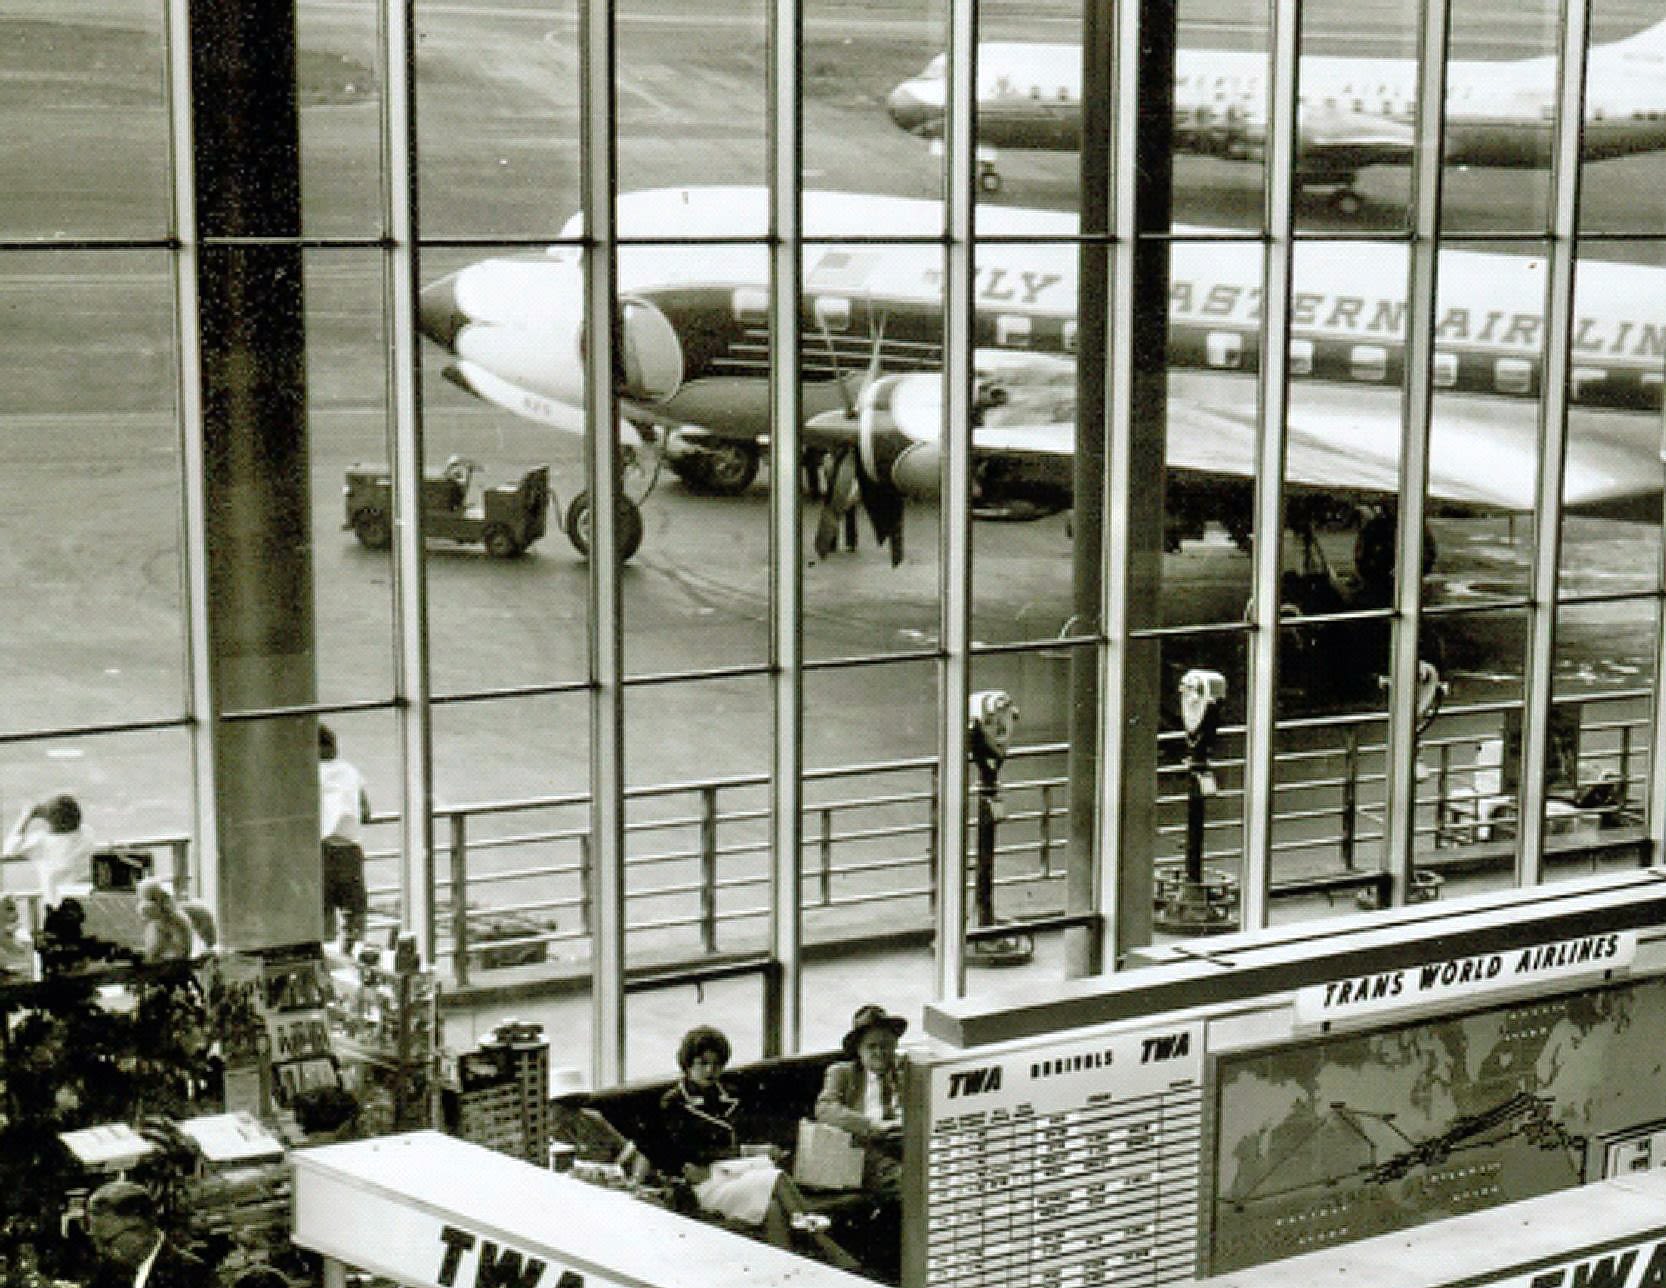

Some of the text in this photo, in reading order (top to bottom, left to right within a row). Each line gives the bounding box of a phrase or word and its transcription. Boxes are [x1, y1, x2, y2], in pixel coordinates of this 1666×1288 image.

[1323, 934, 1619, 1008] TRANS WORLD AIRLINES
[948, 1066, 1002, 1098] TWA
[1141, 1032, 1190, 1064] TWA
